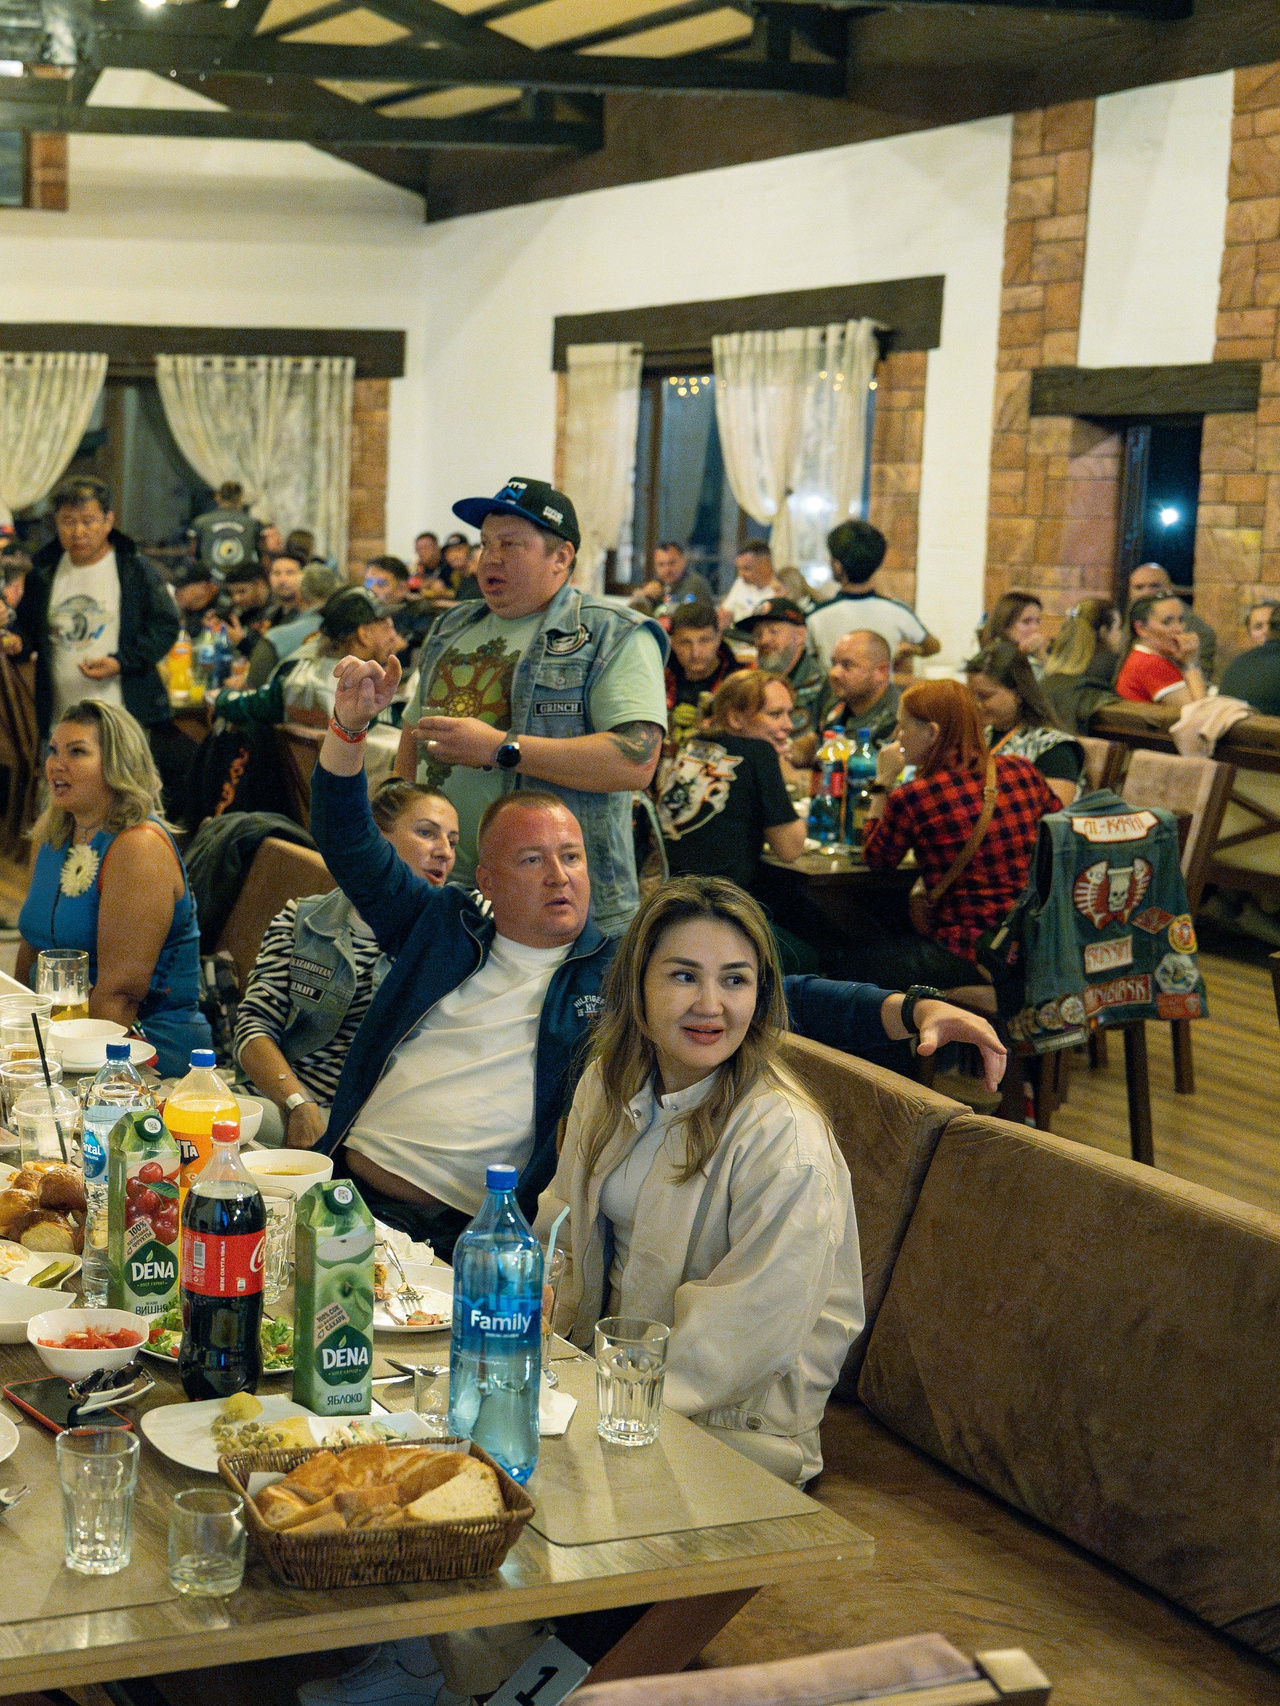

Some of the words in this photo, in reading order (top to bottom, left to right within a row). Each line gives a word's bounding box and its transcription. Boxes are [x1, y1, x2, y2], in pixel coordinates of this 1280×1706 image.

[540, 703, 579, 713] GRINCH
[128, 1221, 147, 1237] 100%
[131, 1261, 175, 1282] DENA
[135, 1304, 168, 1315] ВИШНЯ
[471, 1309, 532, 1334] Family
[322, 1346, 369, 1370] DENA
[327, 1392, 363, 1406] ЯБЛОКО
